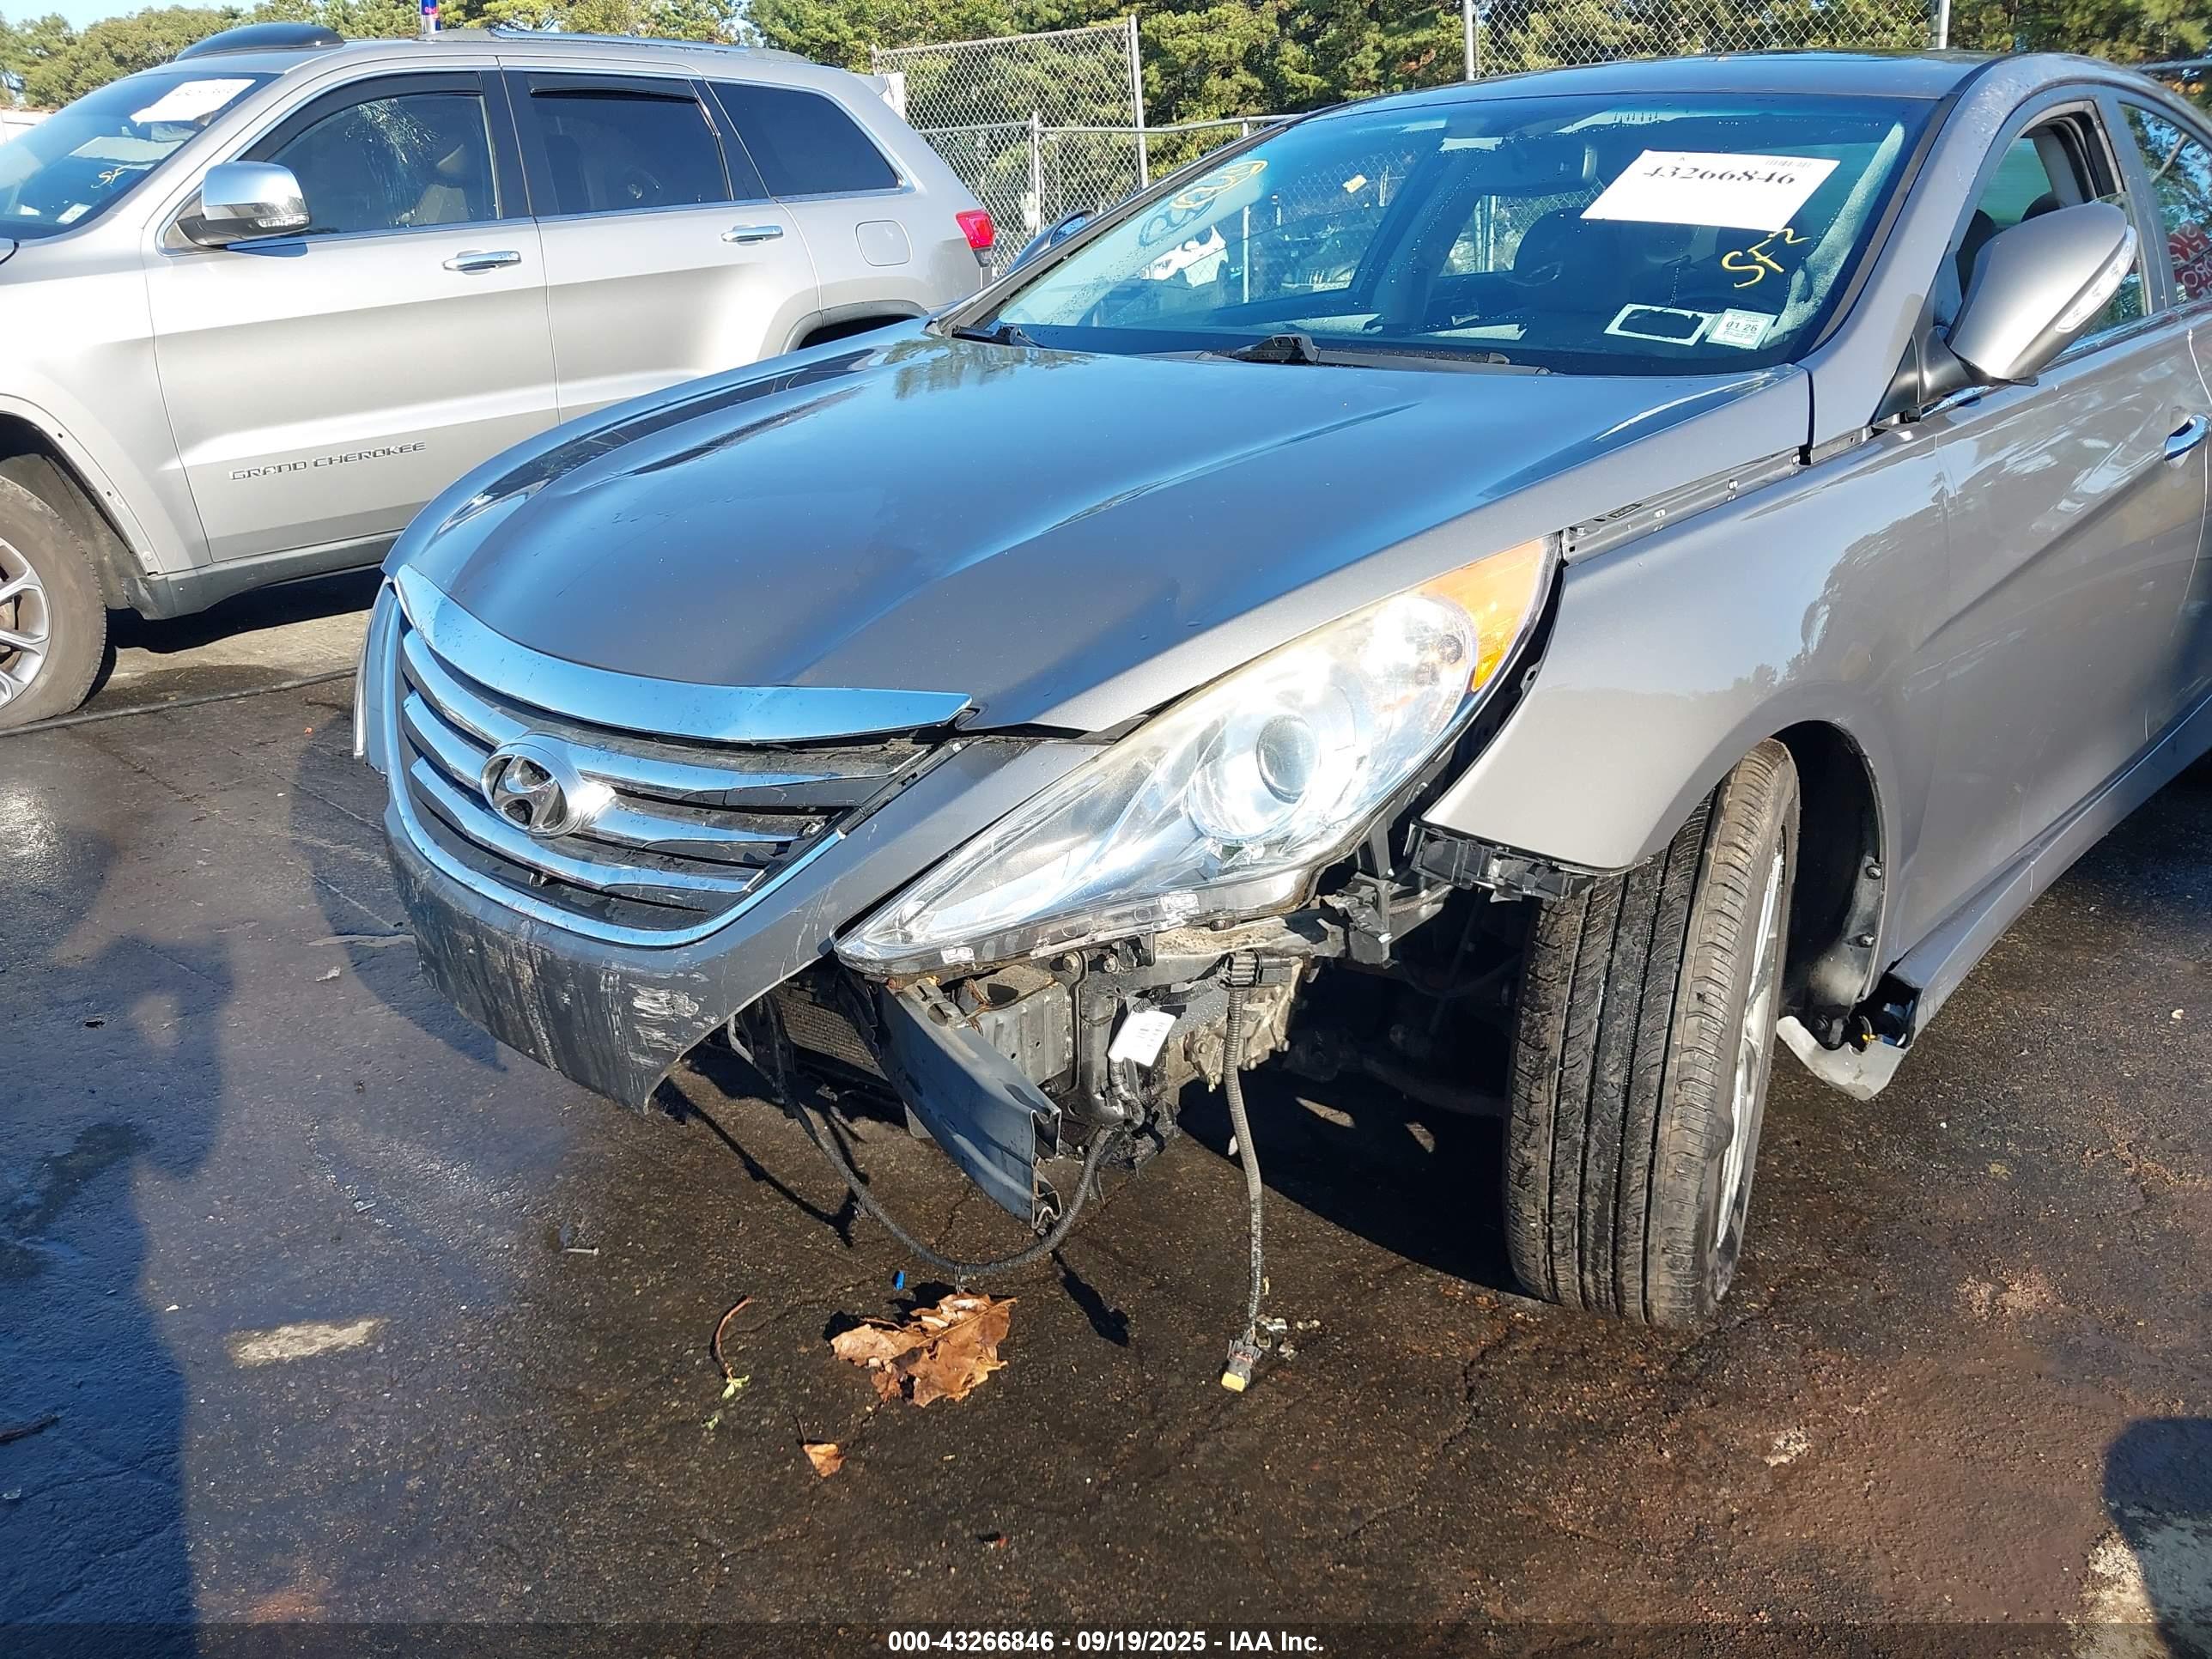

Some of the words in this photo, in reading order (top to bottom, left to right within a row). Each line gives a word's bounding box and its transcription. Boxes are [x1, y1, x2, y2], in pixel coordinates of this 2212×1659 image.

[1644, 165, 1796, 185] 43266846
[230, 460, 307, 480] GRAND
[313, 441, 427, 467] CHEROKEE
